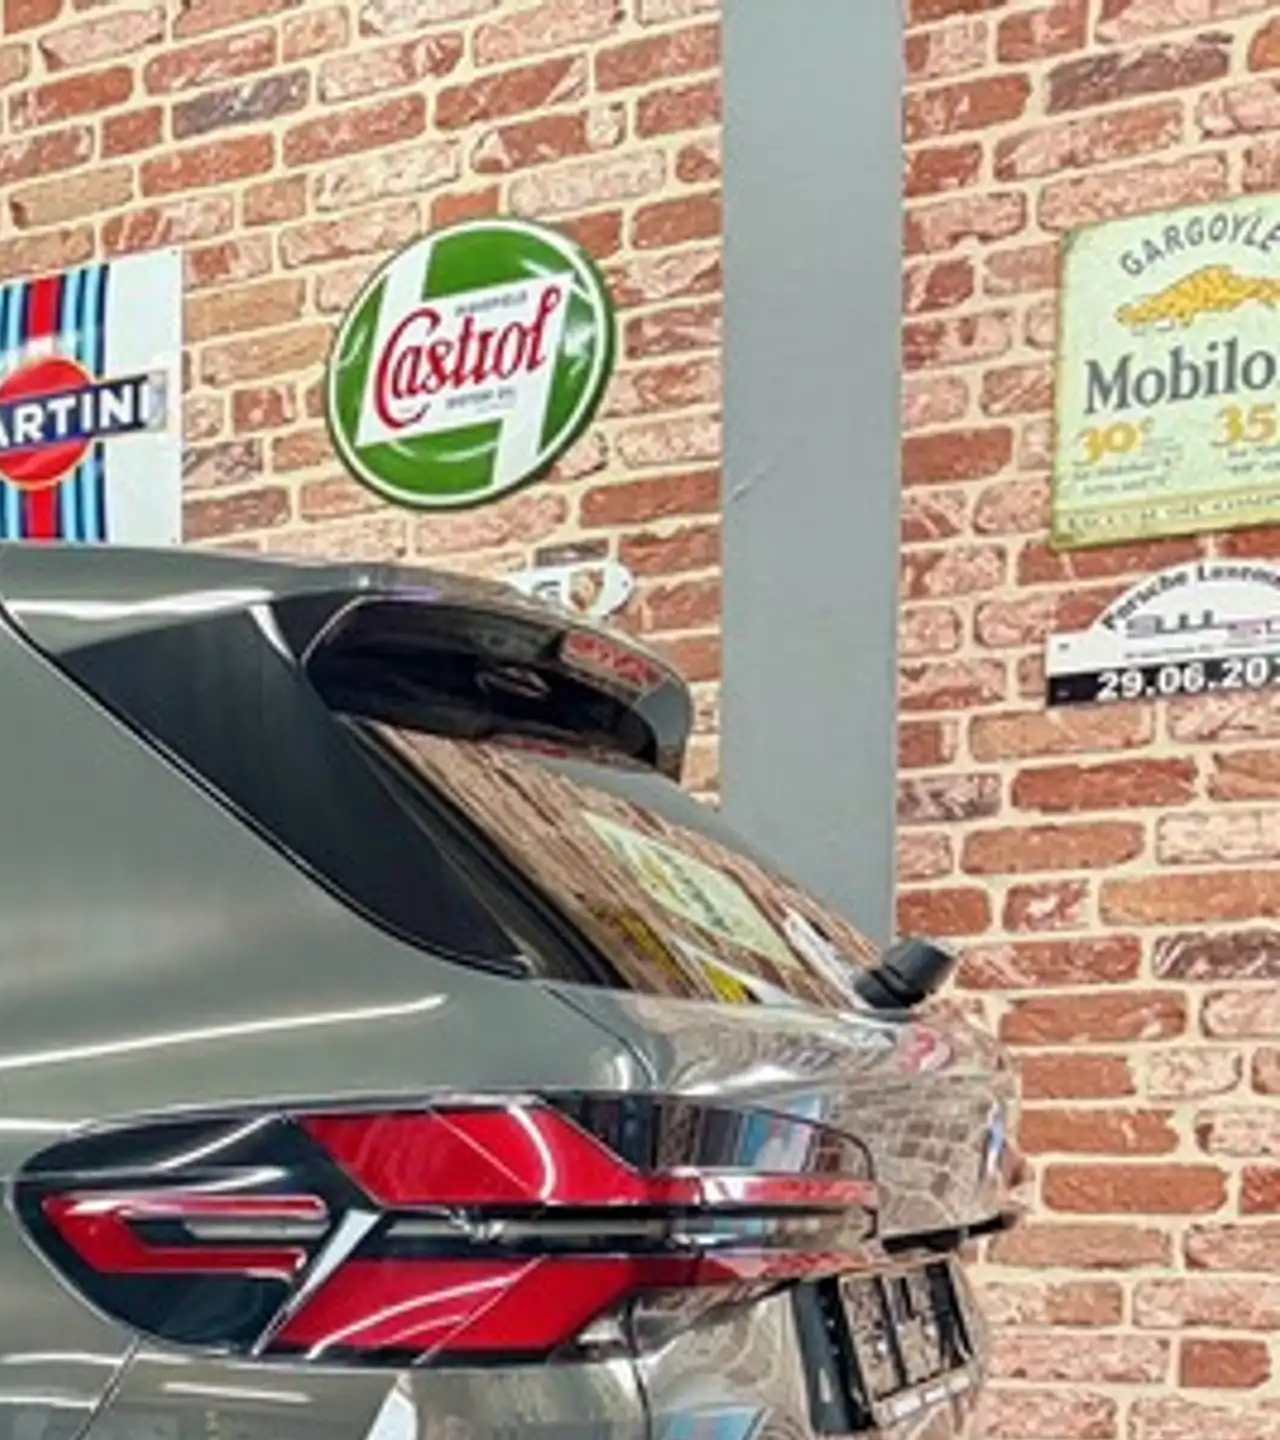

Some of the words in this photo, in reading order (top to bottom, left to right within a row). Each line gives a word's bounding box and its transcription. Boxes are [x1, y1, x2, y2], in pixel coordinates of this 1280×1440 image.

[375, 285, 563, 428] Castrol
[1083, 335, 1280, 415] Mobilo
[1096, 656, 1280, 701] 29.06.20
